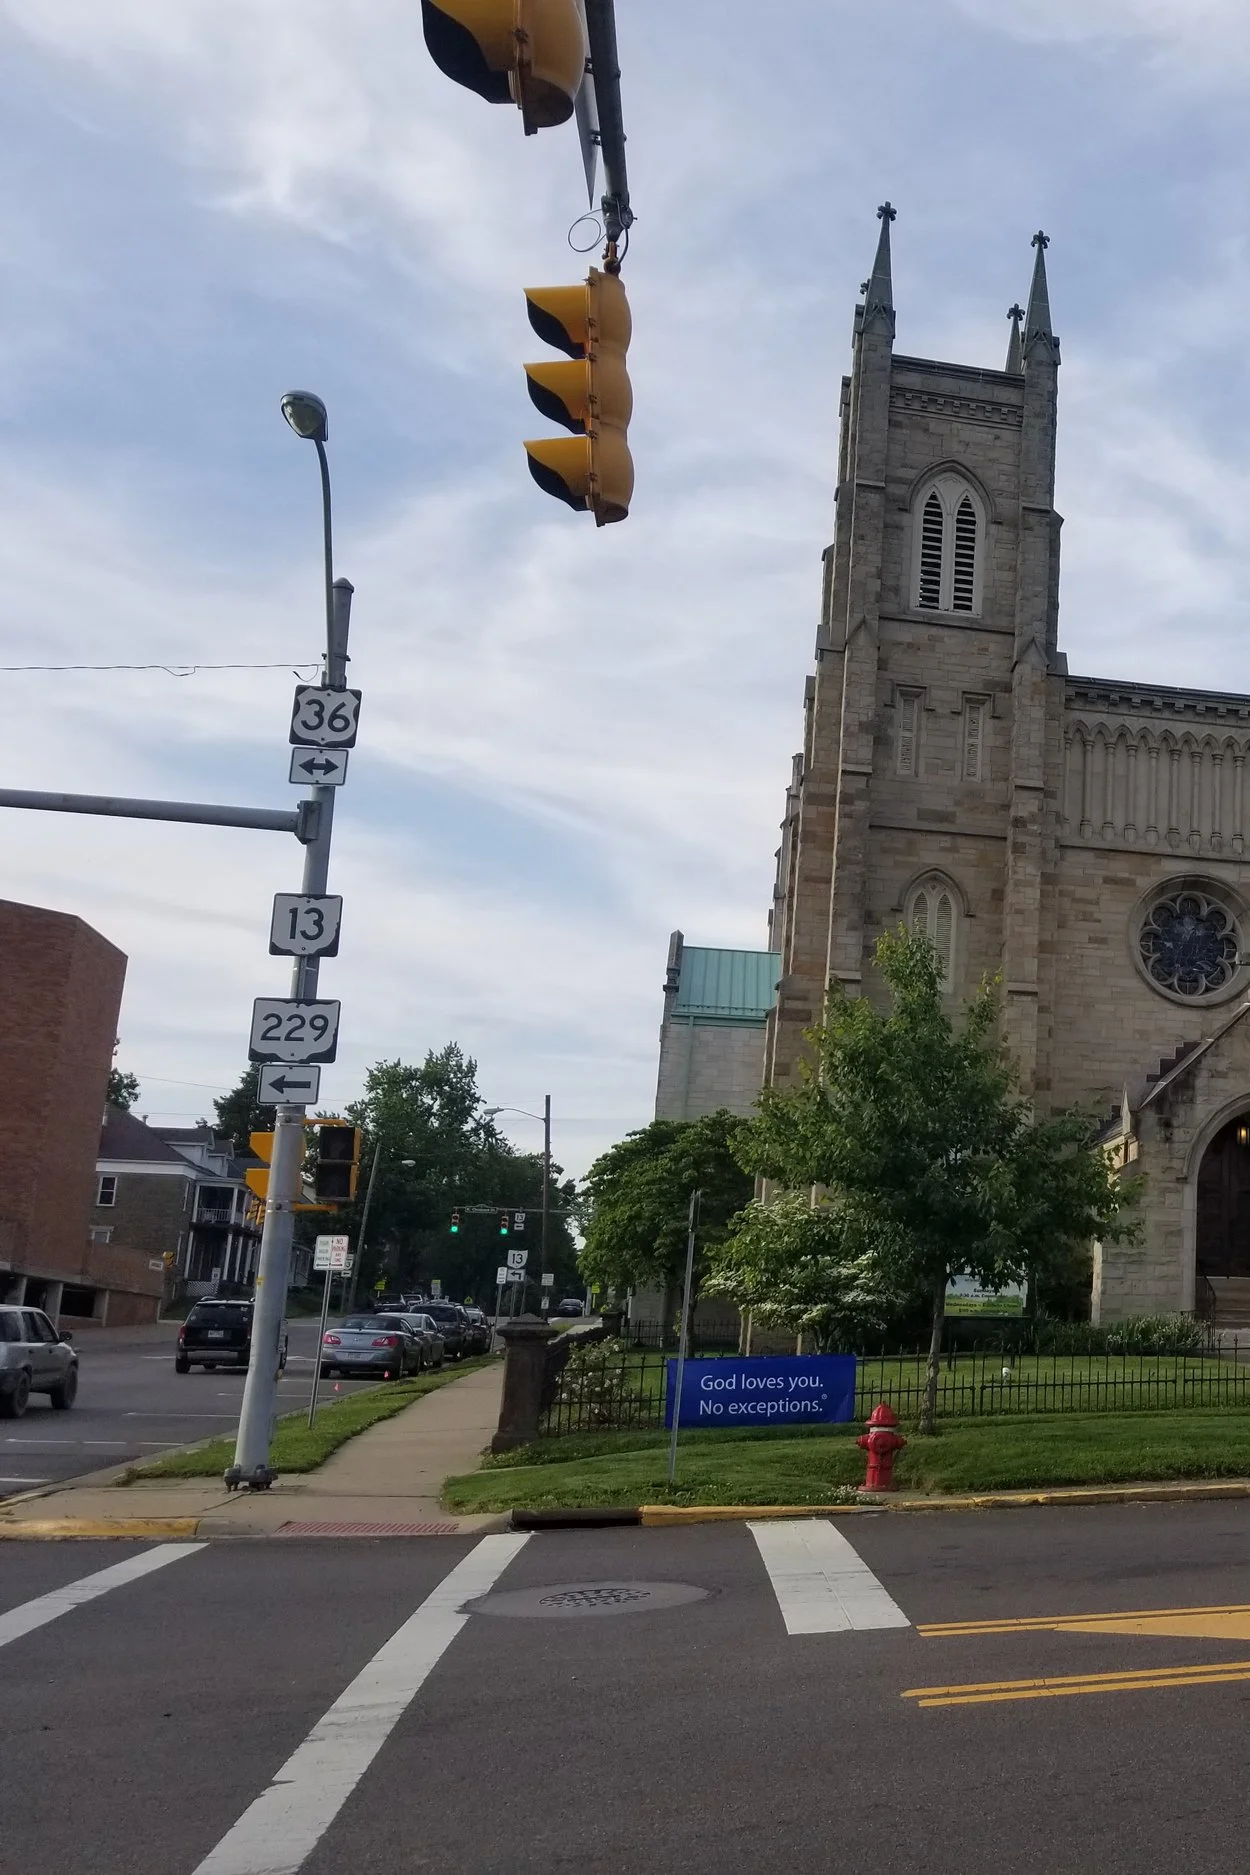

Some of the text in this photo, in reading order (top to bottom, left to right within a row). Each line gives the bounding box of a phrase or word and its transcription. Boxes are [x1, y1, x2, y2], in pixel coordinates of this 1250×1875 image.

[301, 699, 350, 732] 36
[289, 907, 324, 941] 13
[260, 1013, 329, 1042] 229
[512, 1253, 523, 1264] 13
[700, 1373, 824, 1392] God loves you.
[700, 1399, 724, 1415] No
